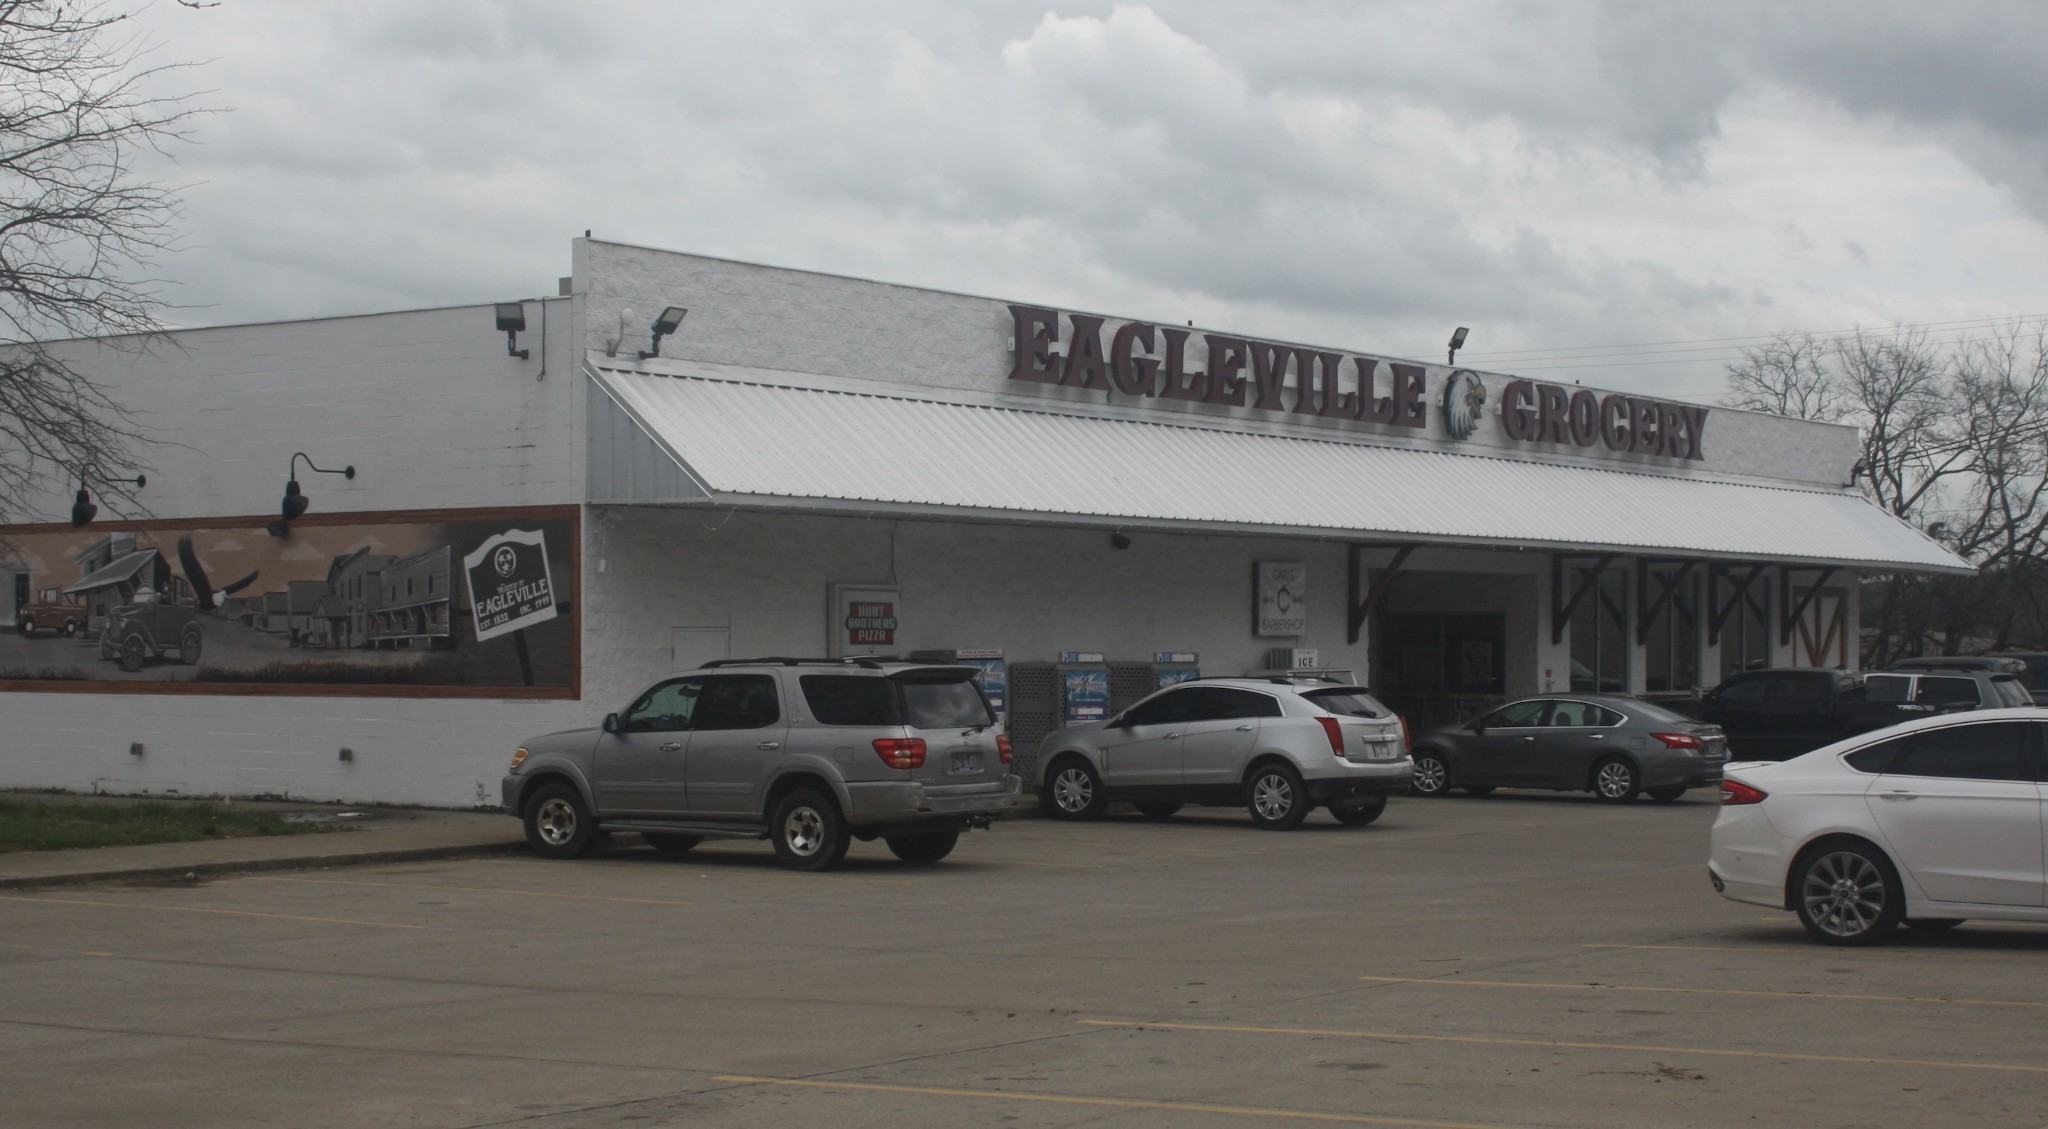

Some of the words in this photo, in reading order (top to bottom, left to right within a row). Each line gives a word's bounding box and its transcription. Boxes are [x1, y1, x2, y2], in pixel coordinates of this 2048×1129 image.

[1007, 304, 1427, 429] EAGLEVILLE
[1500, 380, 1710, 462] GROCERY
[476, 578, 549, 619] EAGLEVILLE
[858, 605, 885, 617] HUNT
[494, 612, 510, 626] 1832
[848, 617, 895, 629] BROTHERS
[1262, 618, 1305, 631] BARBERSHOP
[858, 630, 886, 641] PIZZA
[1299, 657, 1313, 667] ICE
